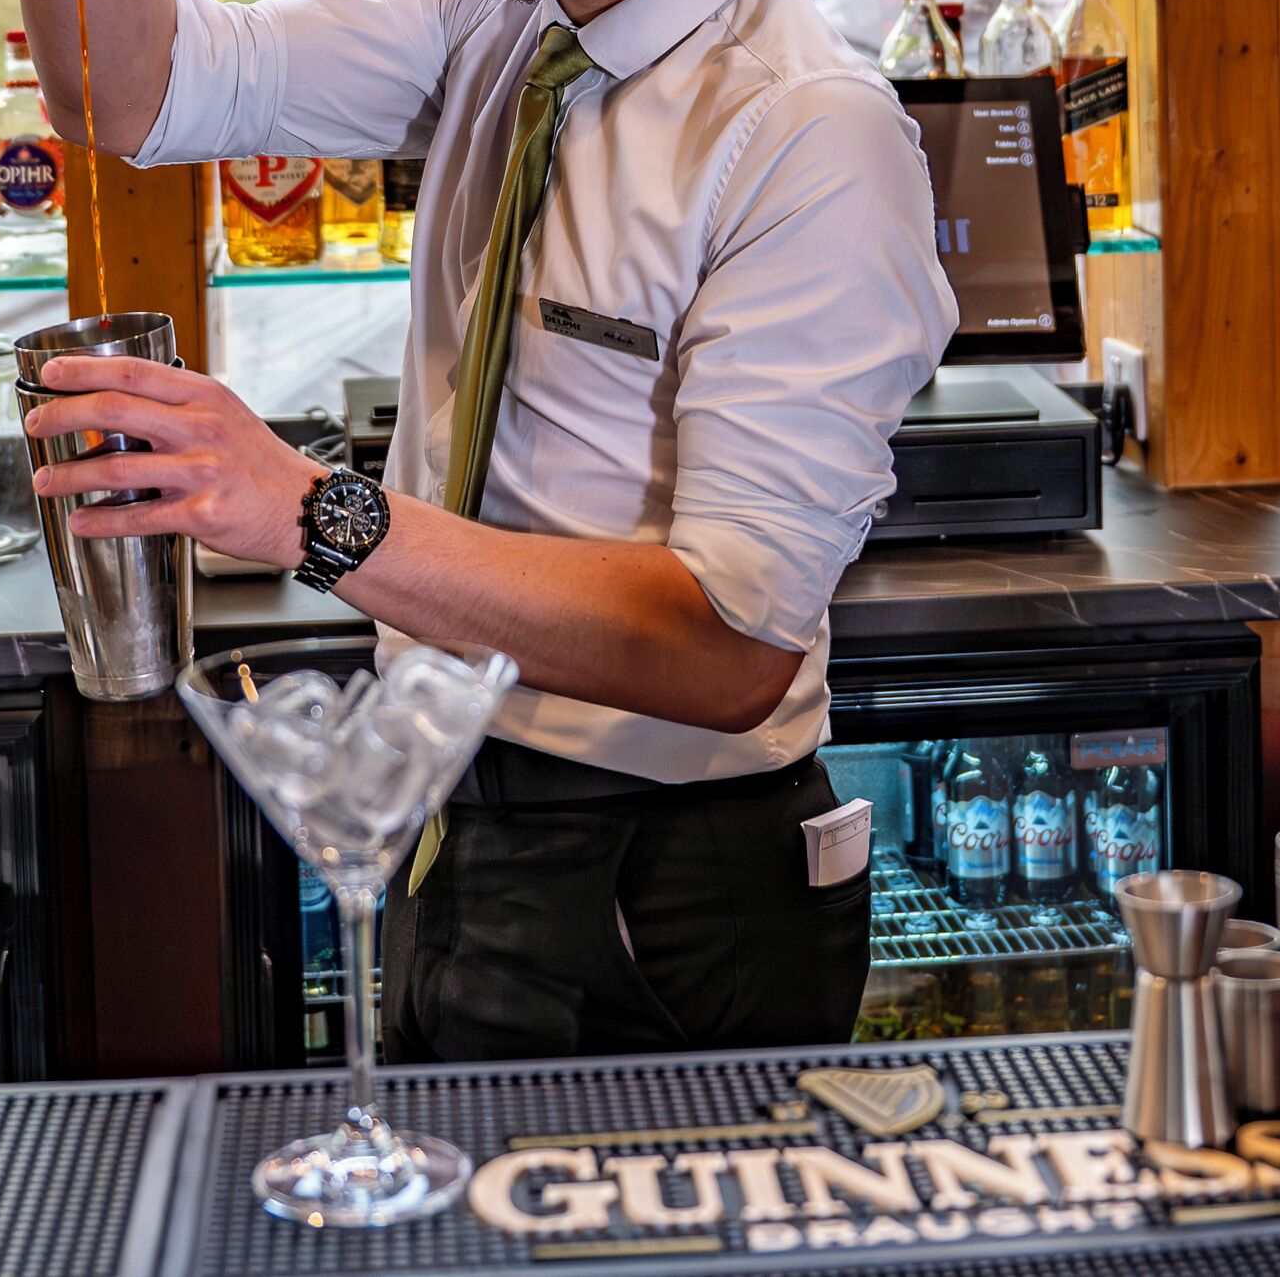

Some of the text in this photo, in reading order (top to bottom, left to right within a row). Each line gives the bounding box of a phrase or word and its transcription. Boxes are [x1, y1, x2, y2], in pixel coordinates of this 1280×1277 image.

[544, 314, 580, 331] DELPHI
[1079, 738, 1158, 761] POLAR
[1095, 827, 1157, 861] Coors
[746, 1200, 1148, 1253] DRAUGHT
